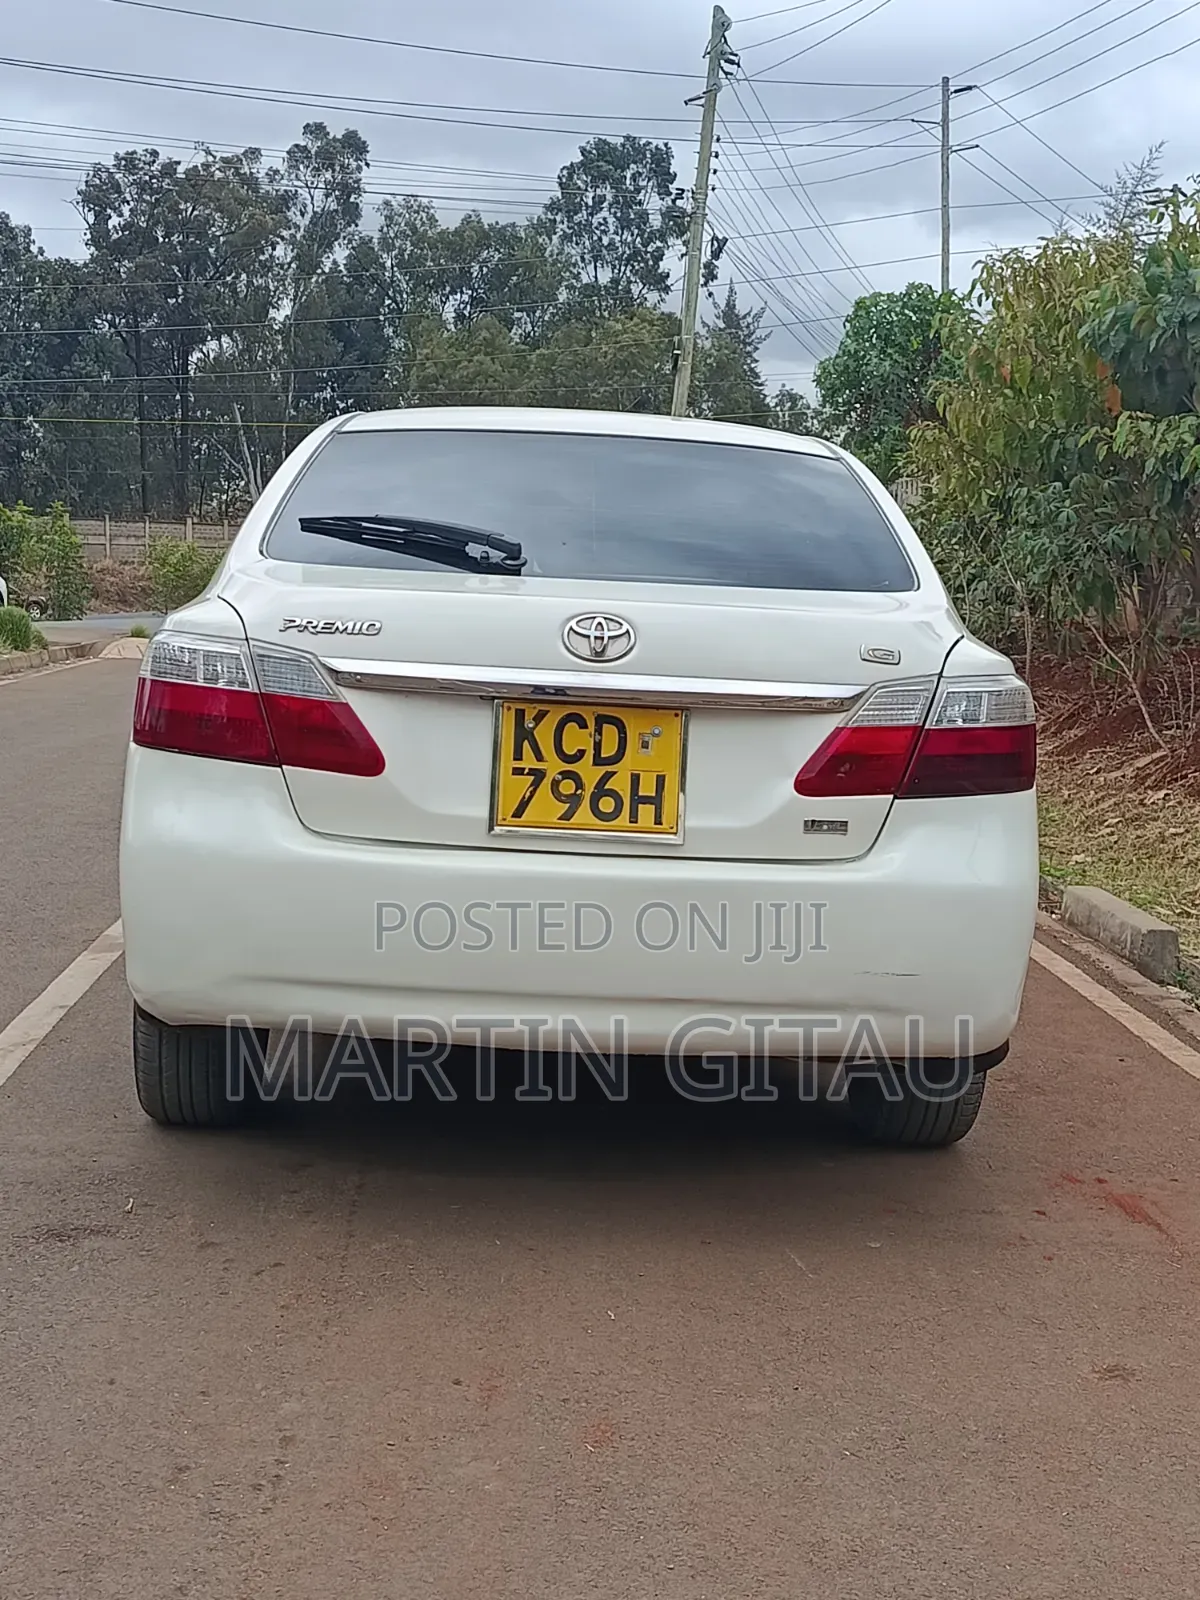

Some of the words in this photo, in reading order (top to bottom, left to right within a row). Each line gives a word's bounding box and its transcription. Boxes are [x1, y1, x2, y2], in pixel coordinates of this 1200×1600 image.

[279, 616, 382, 636] PREMIO
[512, 708, 627, 767] KCD
[511, 766, 666, 826] 796H
